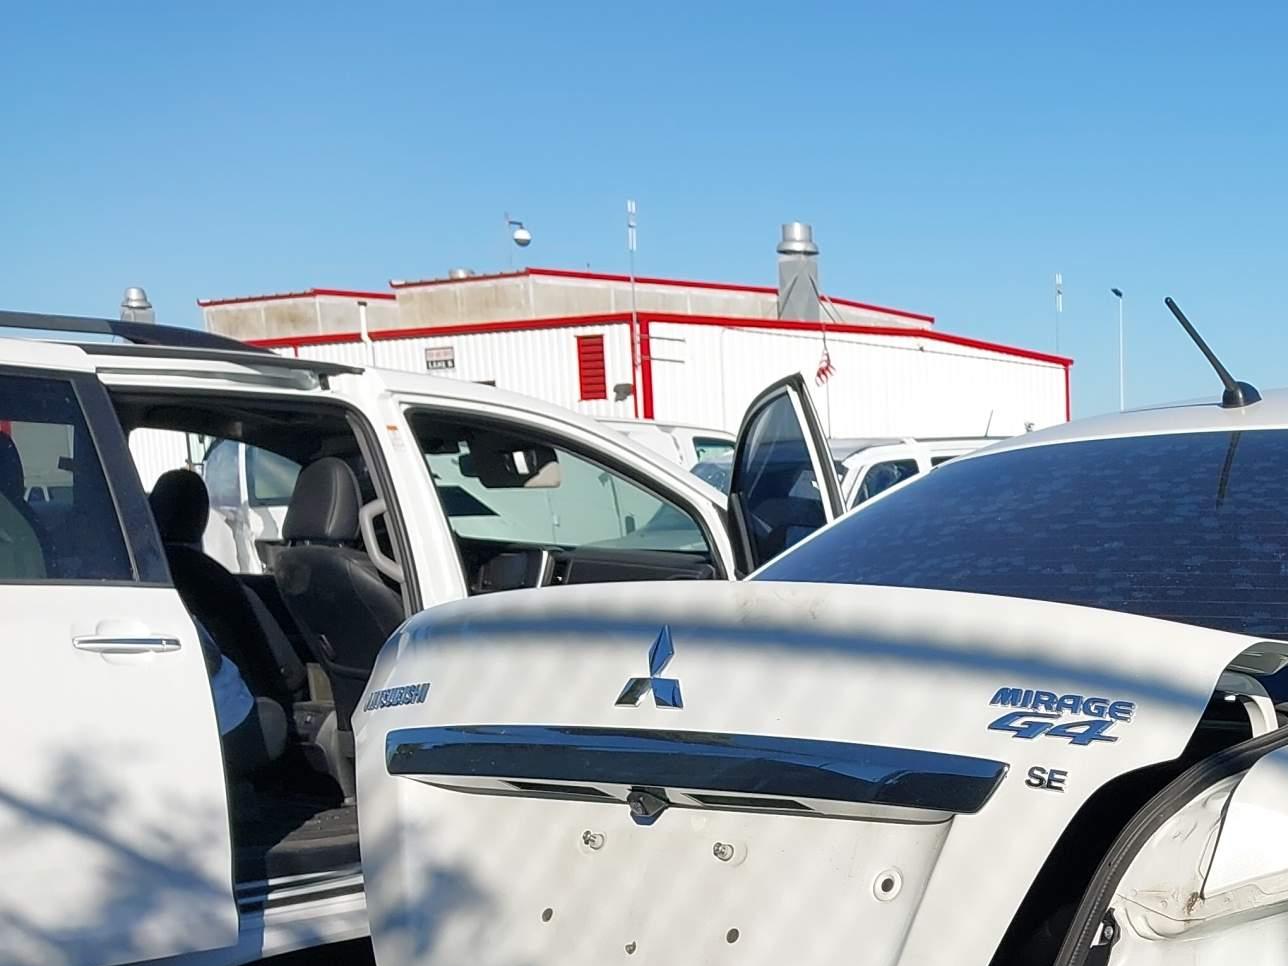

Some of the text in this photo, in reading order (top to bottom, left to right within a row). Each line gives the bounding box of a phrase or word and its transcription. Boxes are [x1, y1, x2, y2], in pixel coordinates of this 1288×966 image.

[988, 687, 1136, 723] MIRAGE
[986, 711, 1119, 746] G4
[1024, 765, 1069, 792] SE
